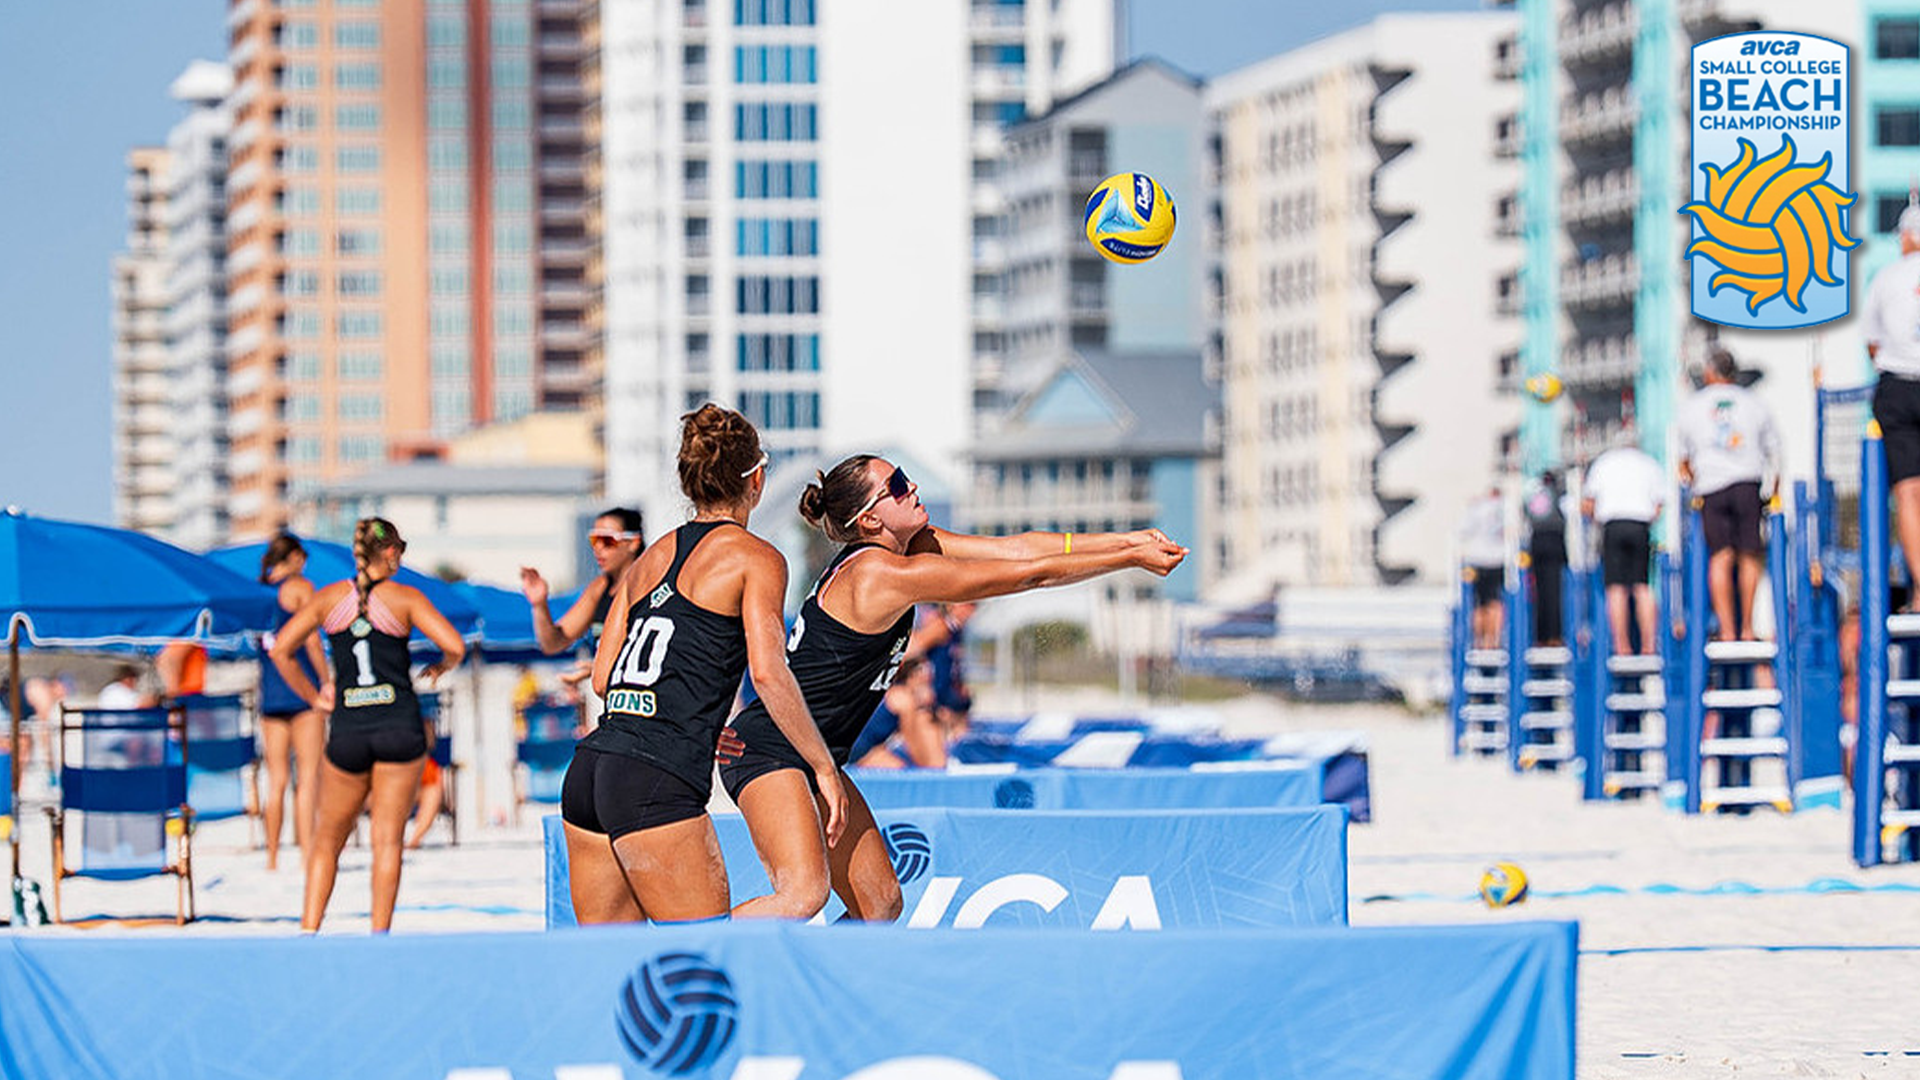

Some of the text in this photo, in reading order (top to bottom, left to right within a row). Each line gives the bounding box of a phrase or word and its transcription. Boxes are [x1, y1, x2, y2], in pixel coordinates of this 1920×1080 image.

[352, 639, 376, 686] 1
[610, 616, 675, 686] 10
[607, 690, 656, 715] IONS
